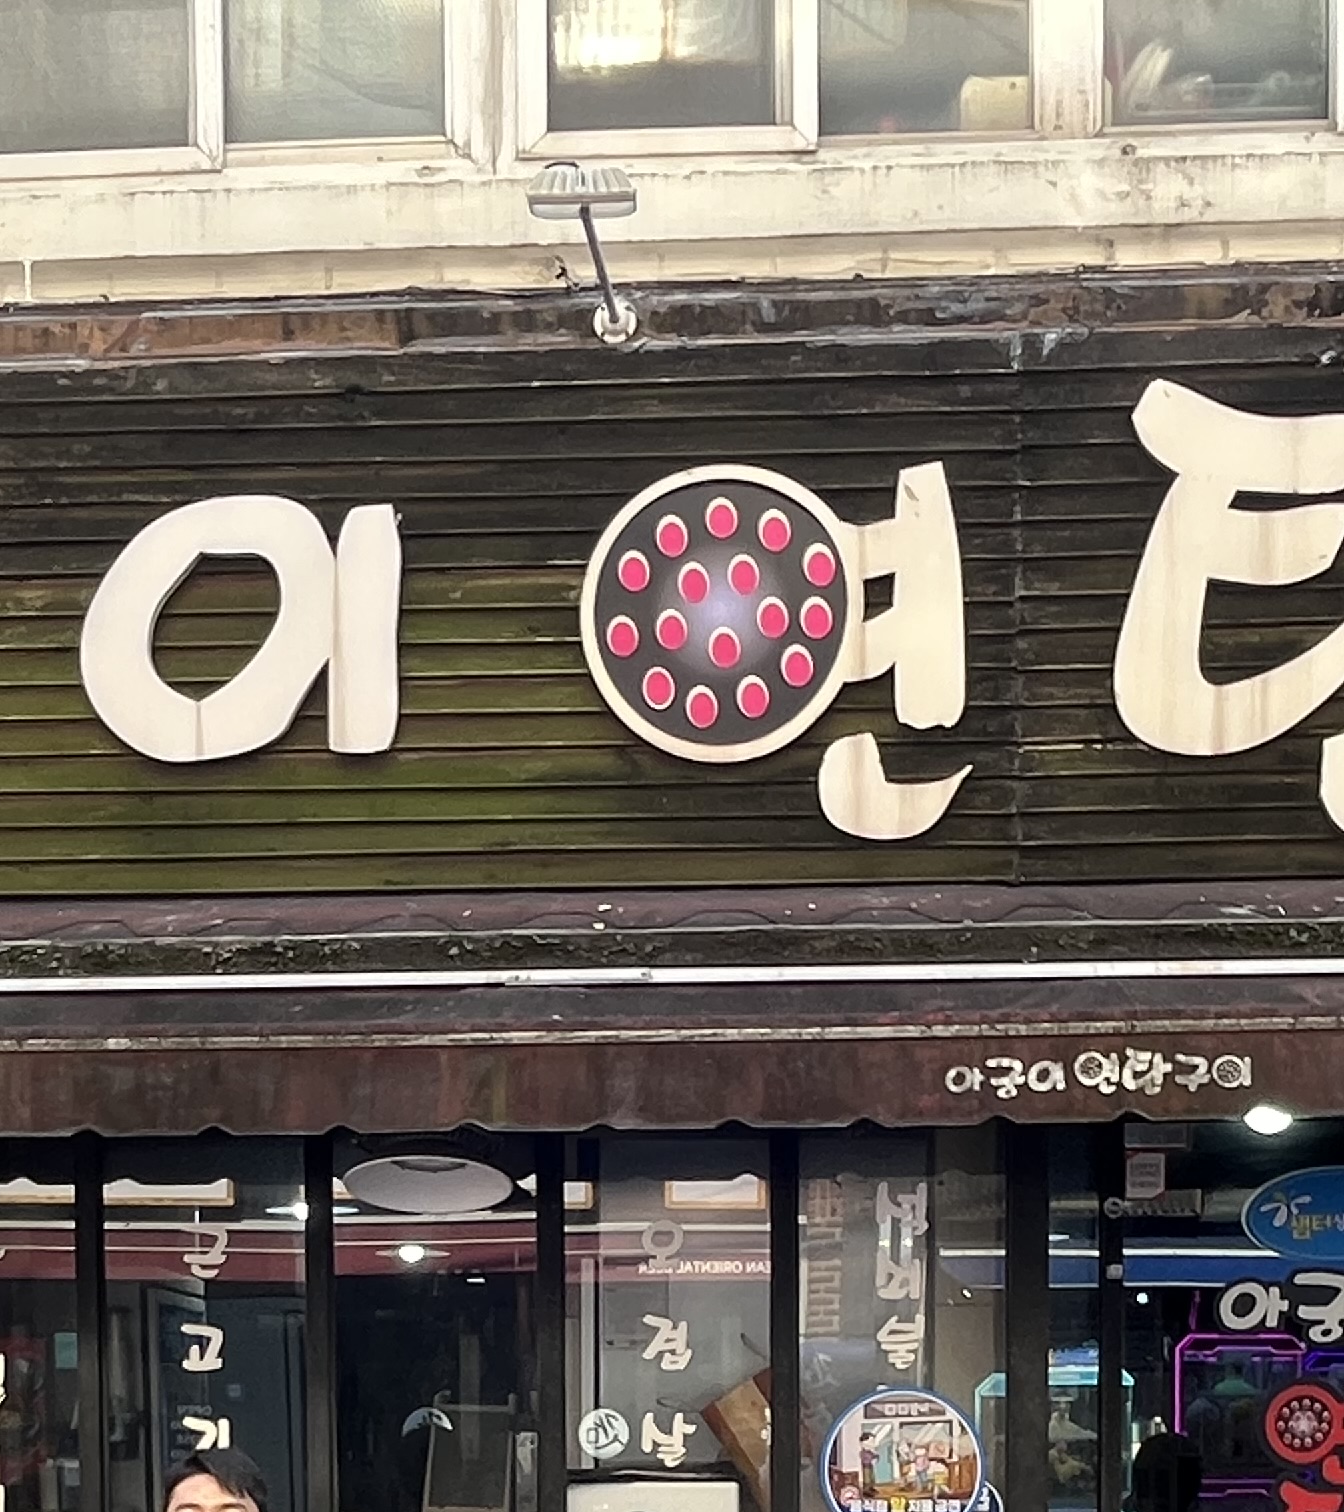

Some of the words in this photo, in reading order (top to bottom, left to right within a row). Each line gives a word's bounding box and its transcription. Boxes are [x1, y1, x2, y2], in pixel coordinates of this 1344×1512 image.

[946, 1058, 1066, 1098] 아궁이
[1073, 1046, 1253, 1093] 연탄구이
[180, 1226, 231, 1450] 근고기
[641, 1220, 697, 1468] 오겹살
